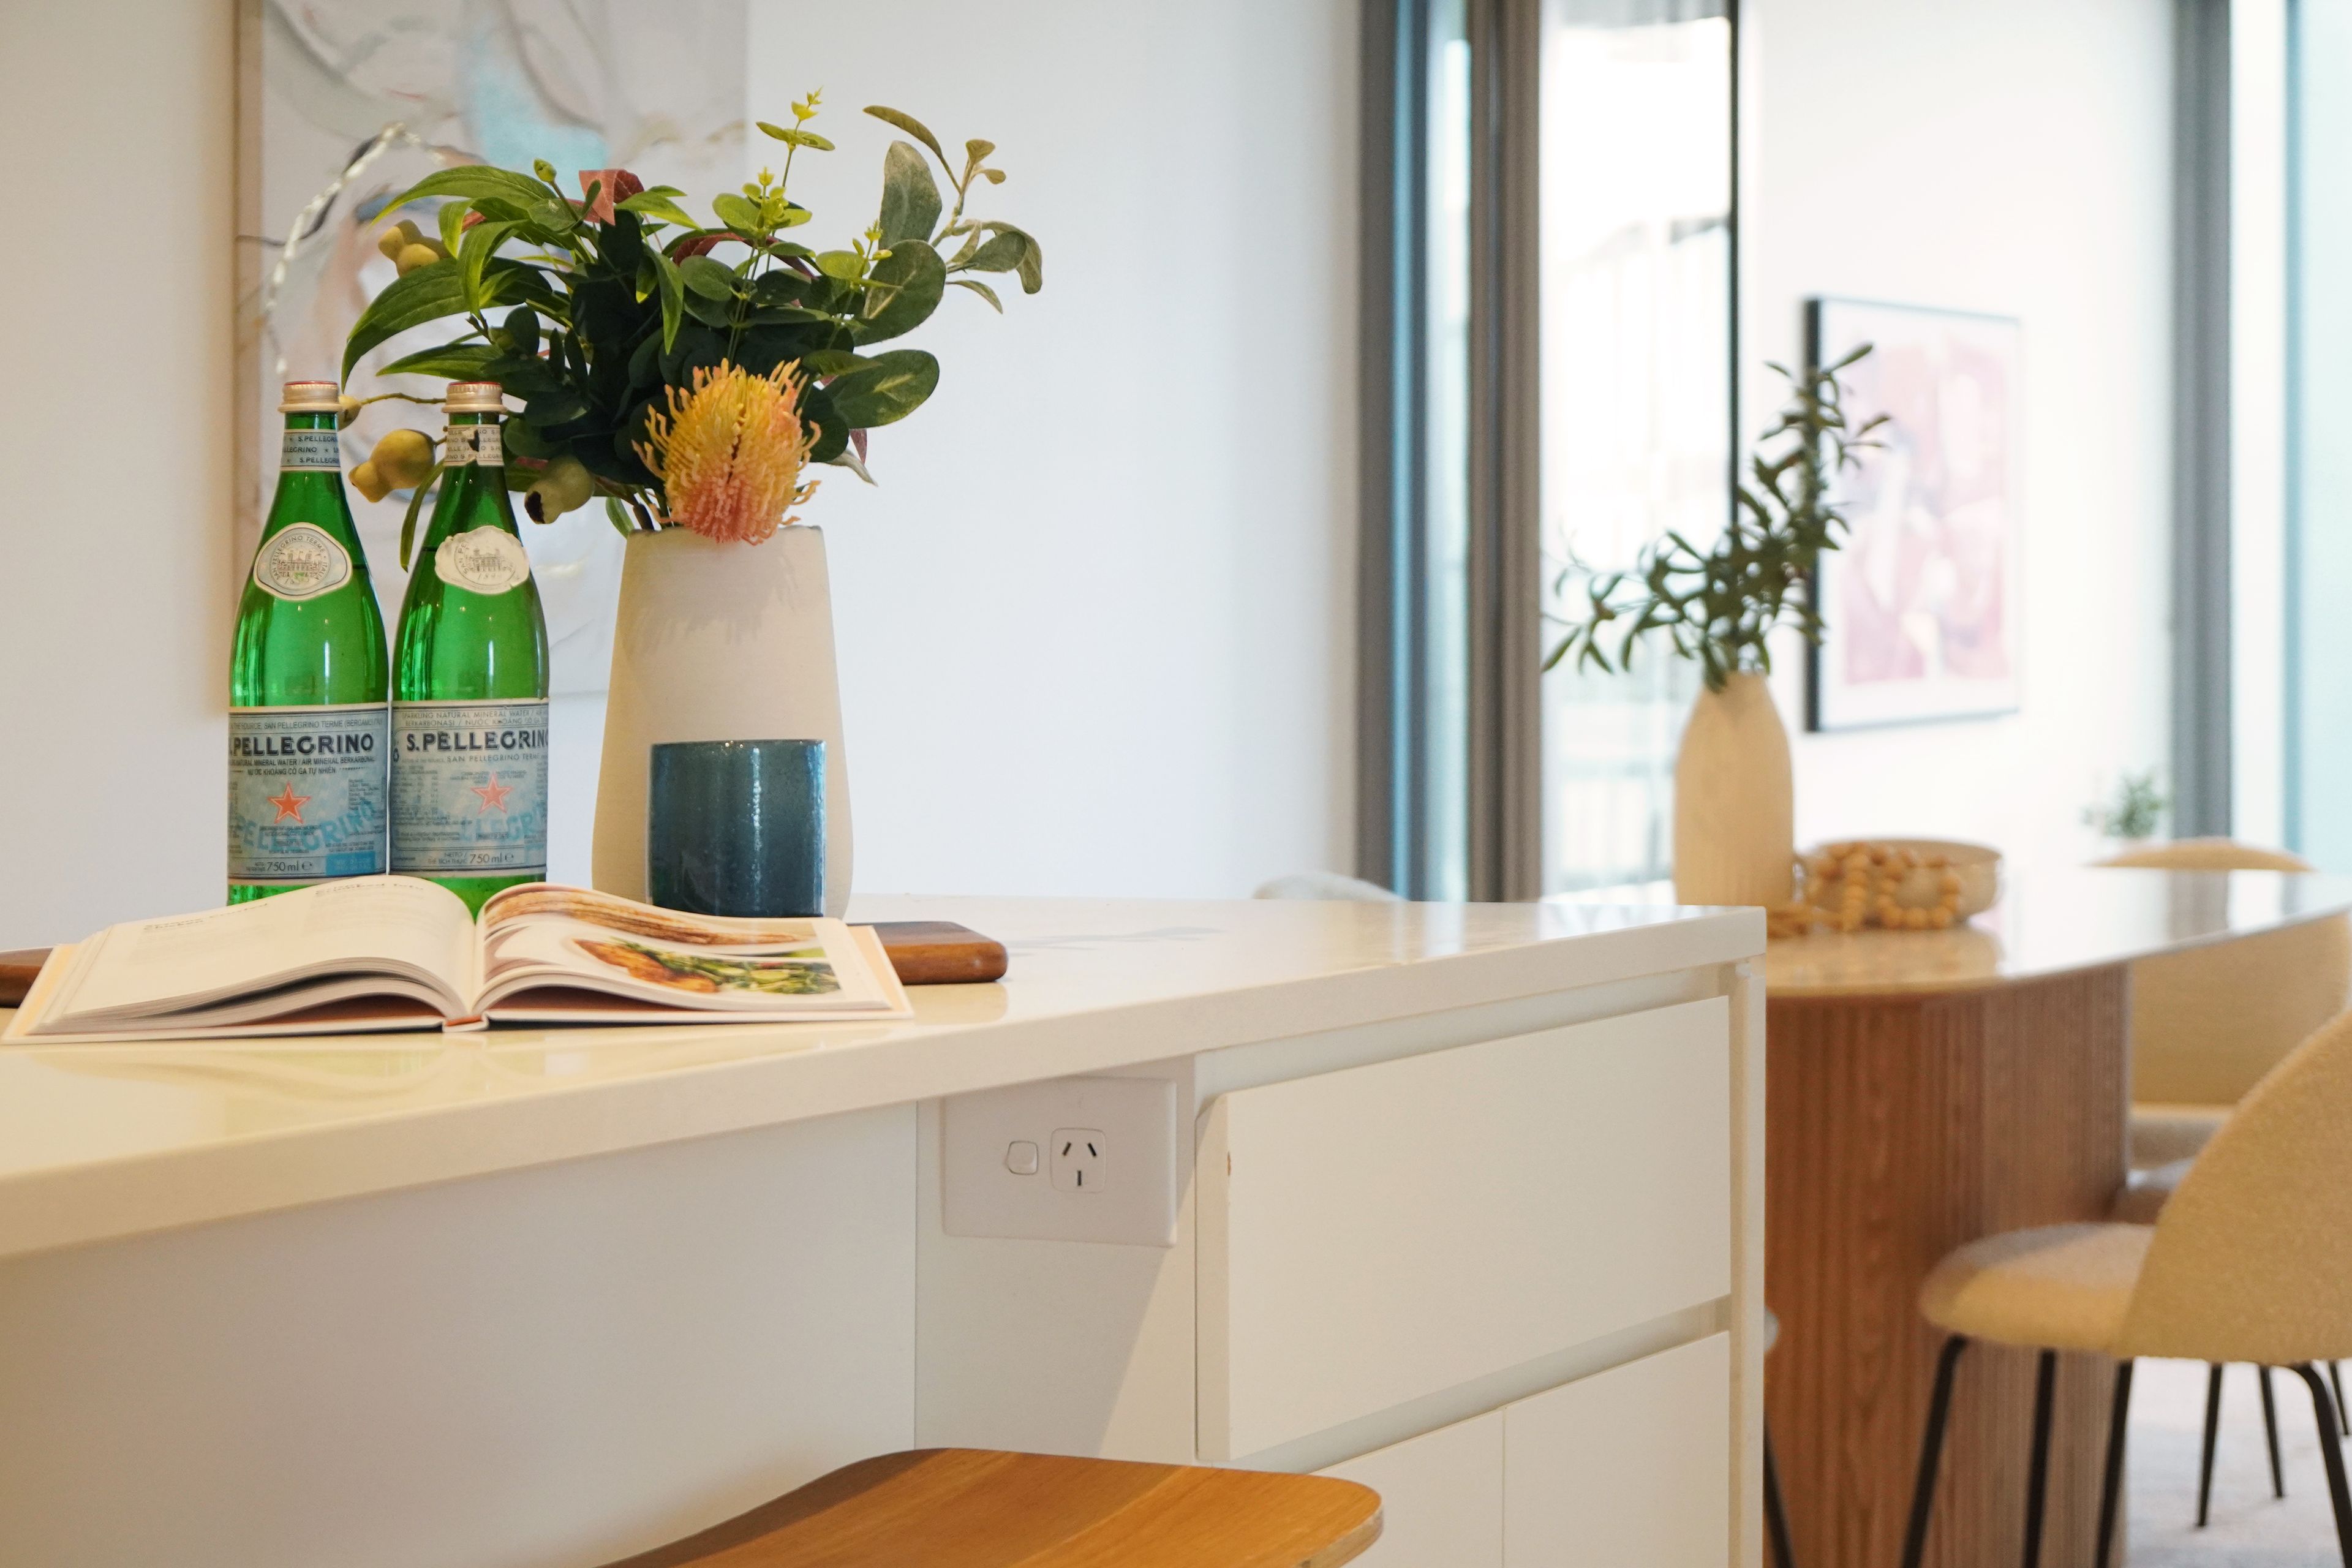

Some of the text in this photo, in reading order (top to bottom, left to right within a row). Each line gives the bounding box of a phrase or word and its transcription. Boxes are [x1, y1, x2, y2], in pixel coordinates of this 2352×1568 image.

[272, 535, 304, 565] PELLEGRINO
[306, 536, 325, 553] TERME
[277, 721, 319, 729] PELLEGRINO
[469, 753, 520, 762] PELLEGRINO
[469, 853, 502, 864] 750 ml
[267, 861, 285, 872] 750
[287, 860, 299, 871] ml
